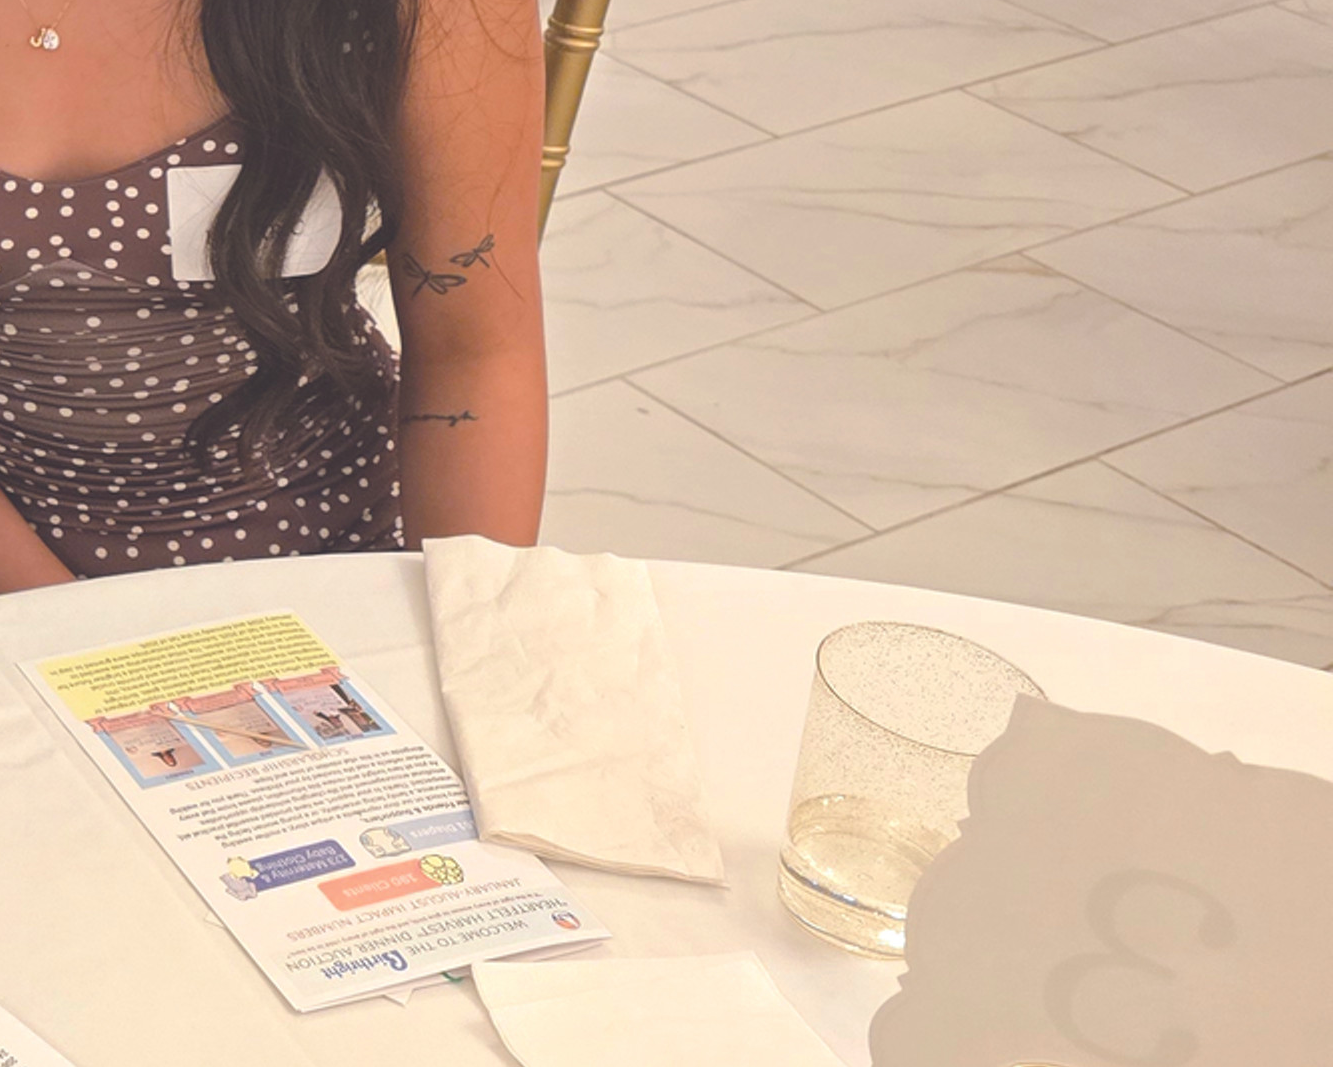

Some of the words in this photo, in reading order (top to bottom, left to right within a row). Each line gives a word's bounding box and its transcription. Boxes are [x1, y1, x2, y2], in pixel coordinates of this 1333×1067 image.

[482, 896, 569, 920] "HEARTFELT
[412, 912, 486, 938] HARVEST"
[457, 918, 530, 942] WELCOME
[352, 930, 414, 953] DINNER
[403, 940, 436, 956] THE
[433, 934, 460, 948] TO
[282, 945, 356, 973] AUCTION
[317, 949, 410, 980] Birthright
